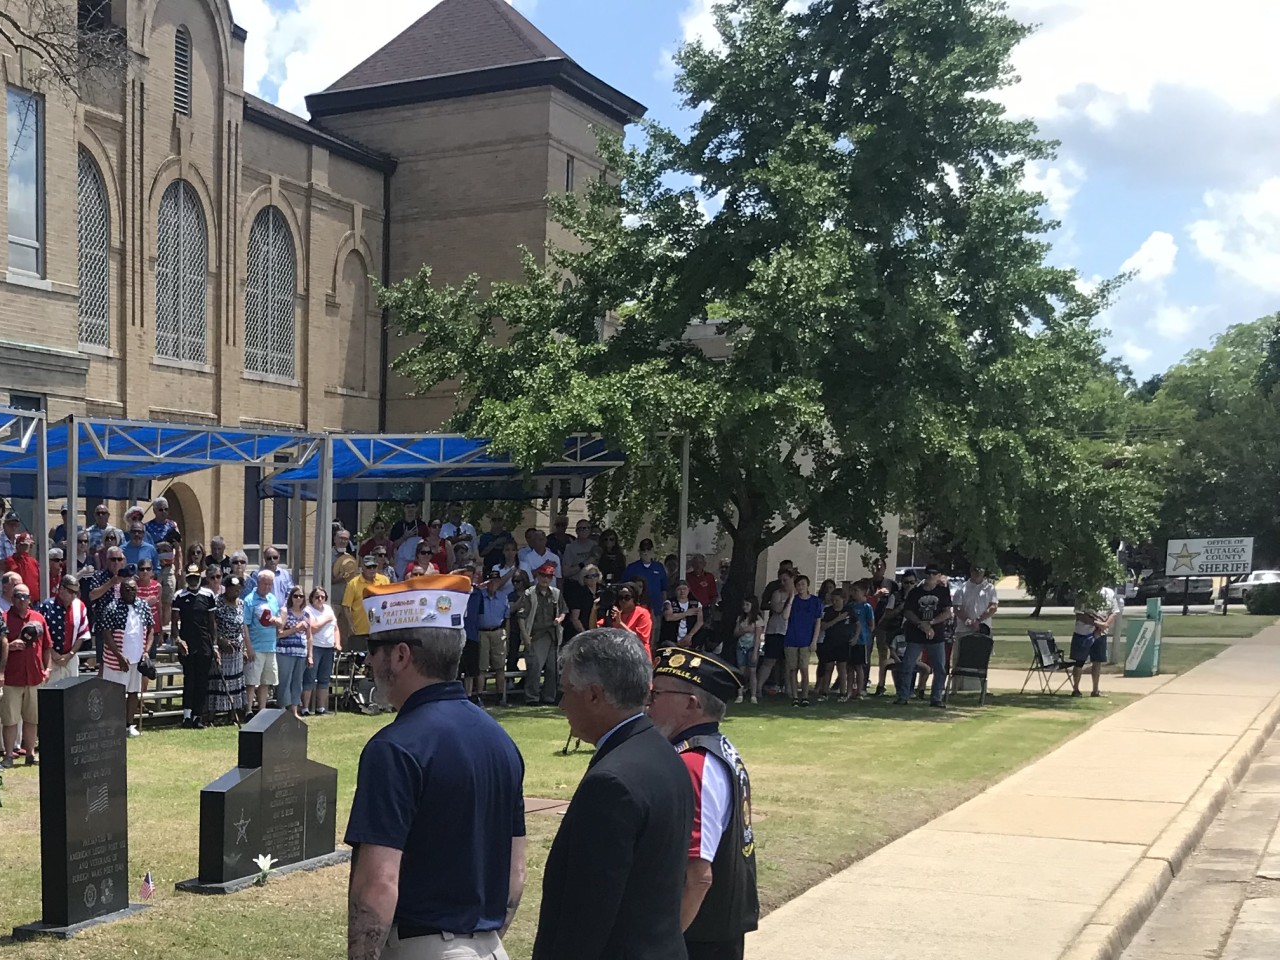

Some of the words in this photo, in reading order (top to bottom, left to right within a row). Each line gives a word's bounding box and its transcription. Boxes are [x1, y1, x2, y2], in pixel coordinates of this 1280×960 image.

[1203, 547, 1246, 555] AUTAUGA
[1198, 562, 1249, 573] SHERIFF
[383, 608, 426, 618] PRATTVILLE
[385, 617, 420, 626] ALABAMA
[692, 675, 702, 683] AL
